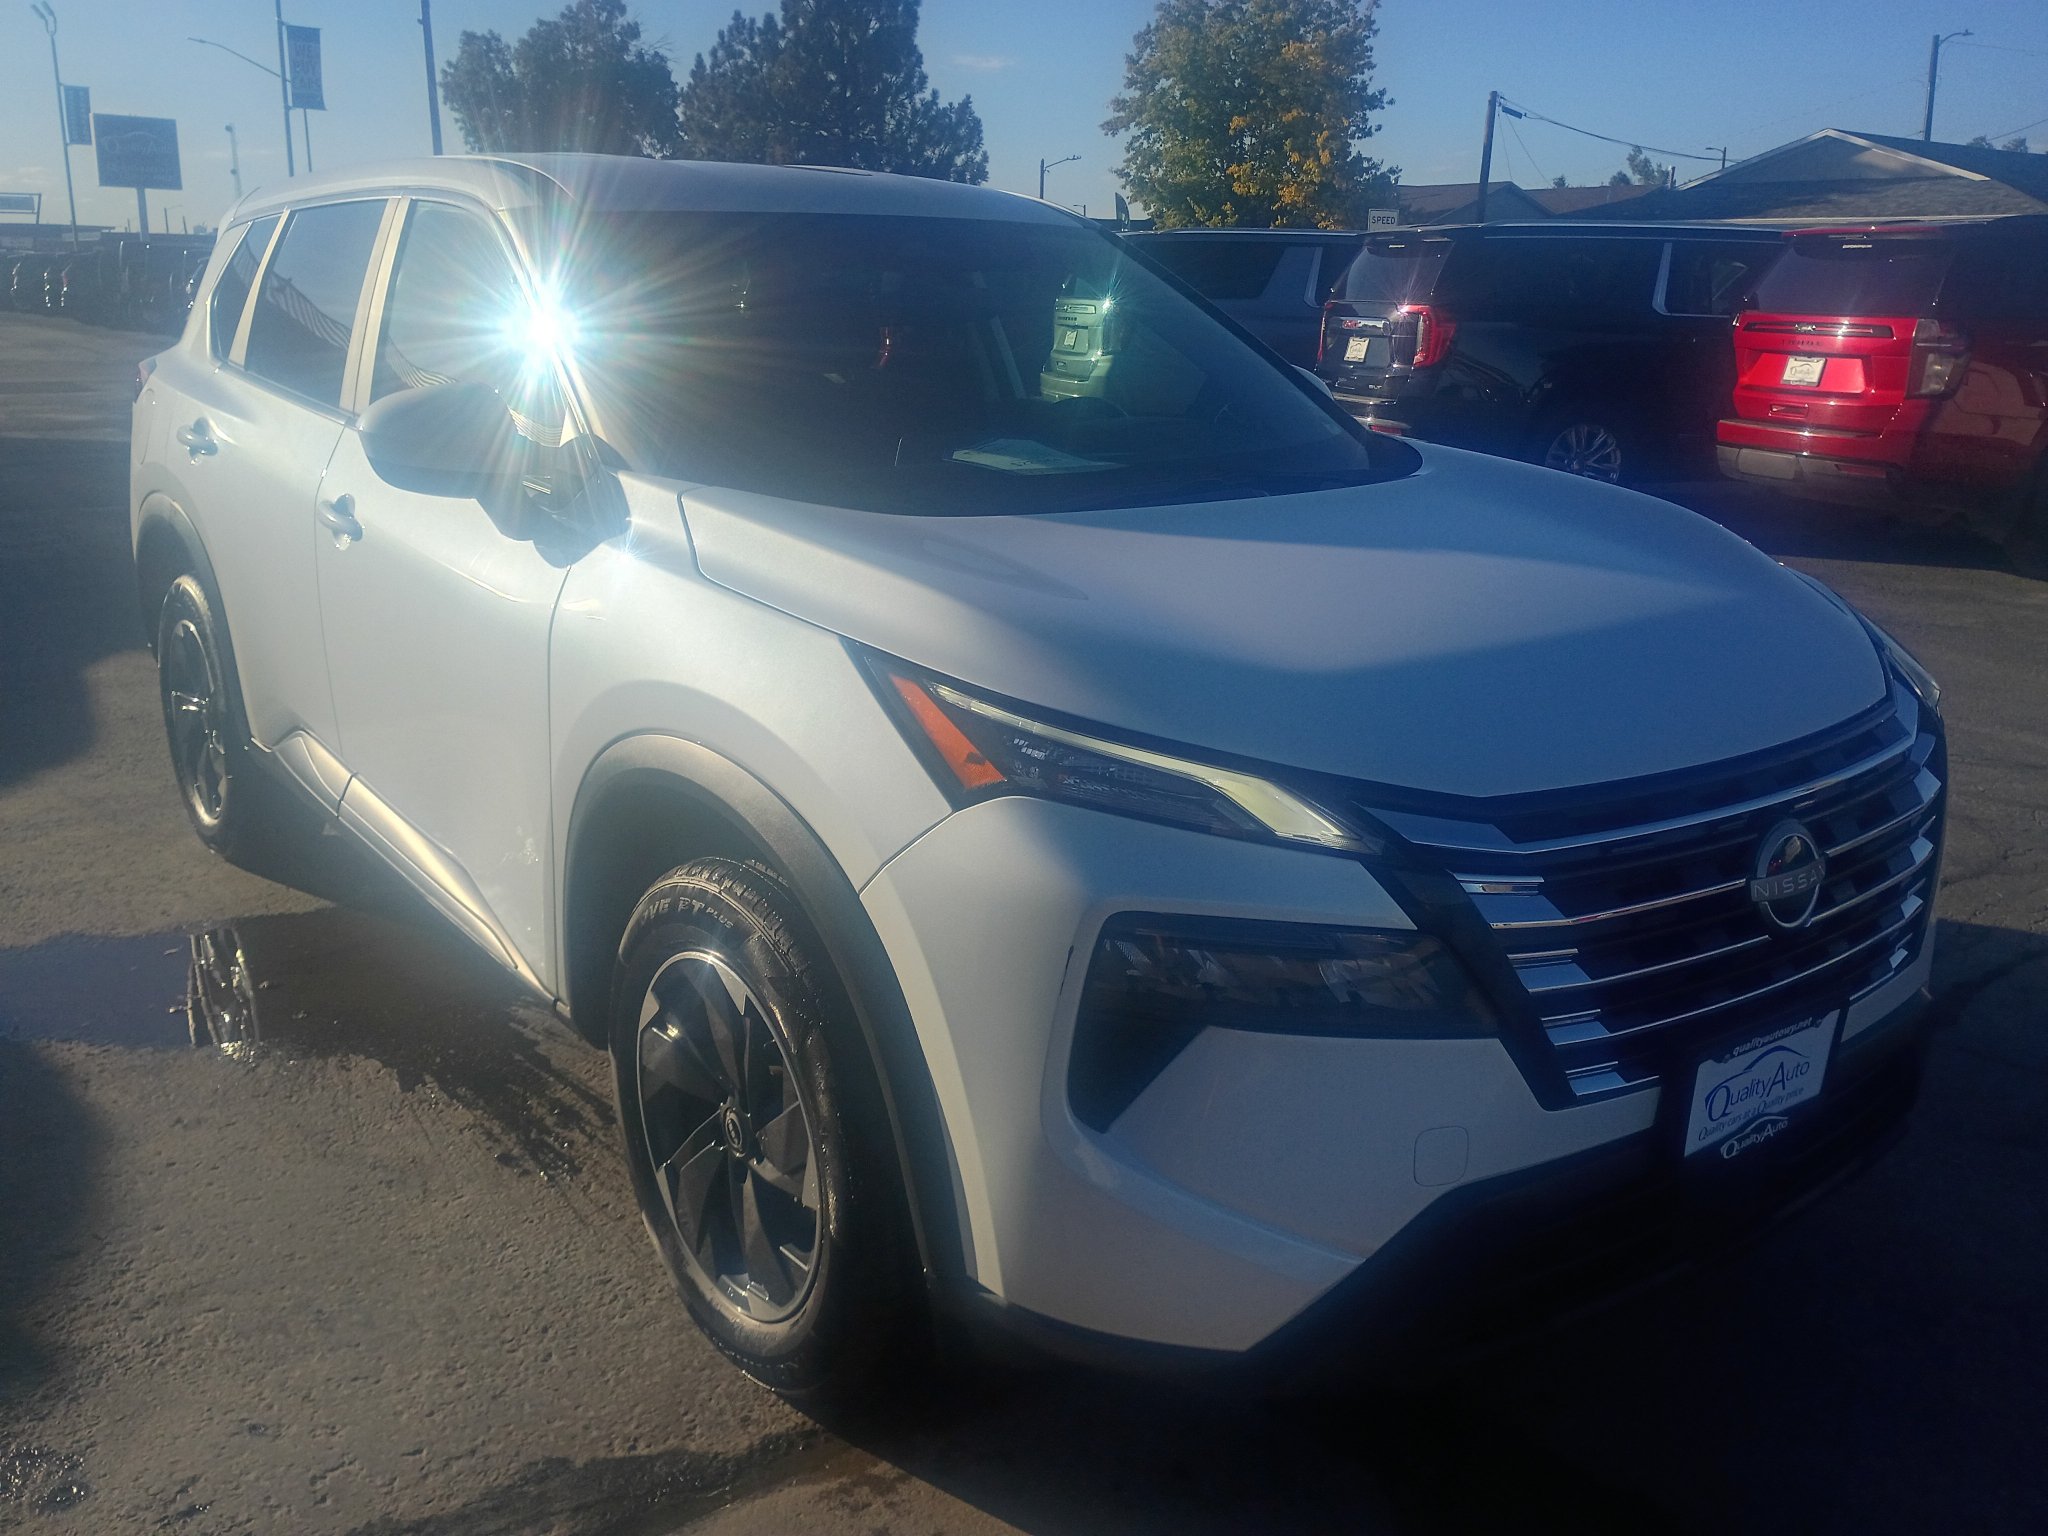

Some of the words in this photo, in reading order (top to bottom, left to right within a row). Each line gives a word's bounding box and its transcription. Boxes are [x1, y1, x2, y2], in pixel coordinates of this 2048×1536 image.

[1371, 215, 1396, 225] SPEED
[1753, 864, 1825, 898] NISSAN
[706, 906, 734, 929] PLUS
